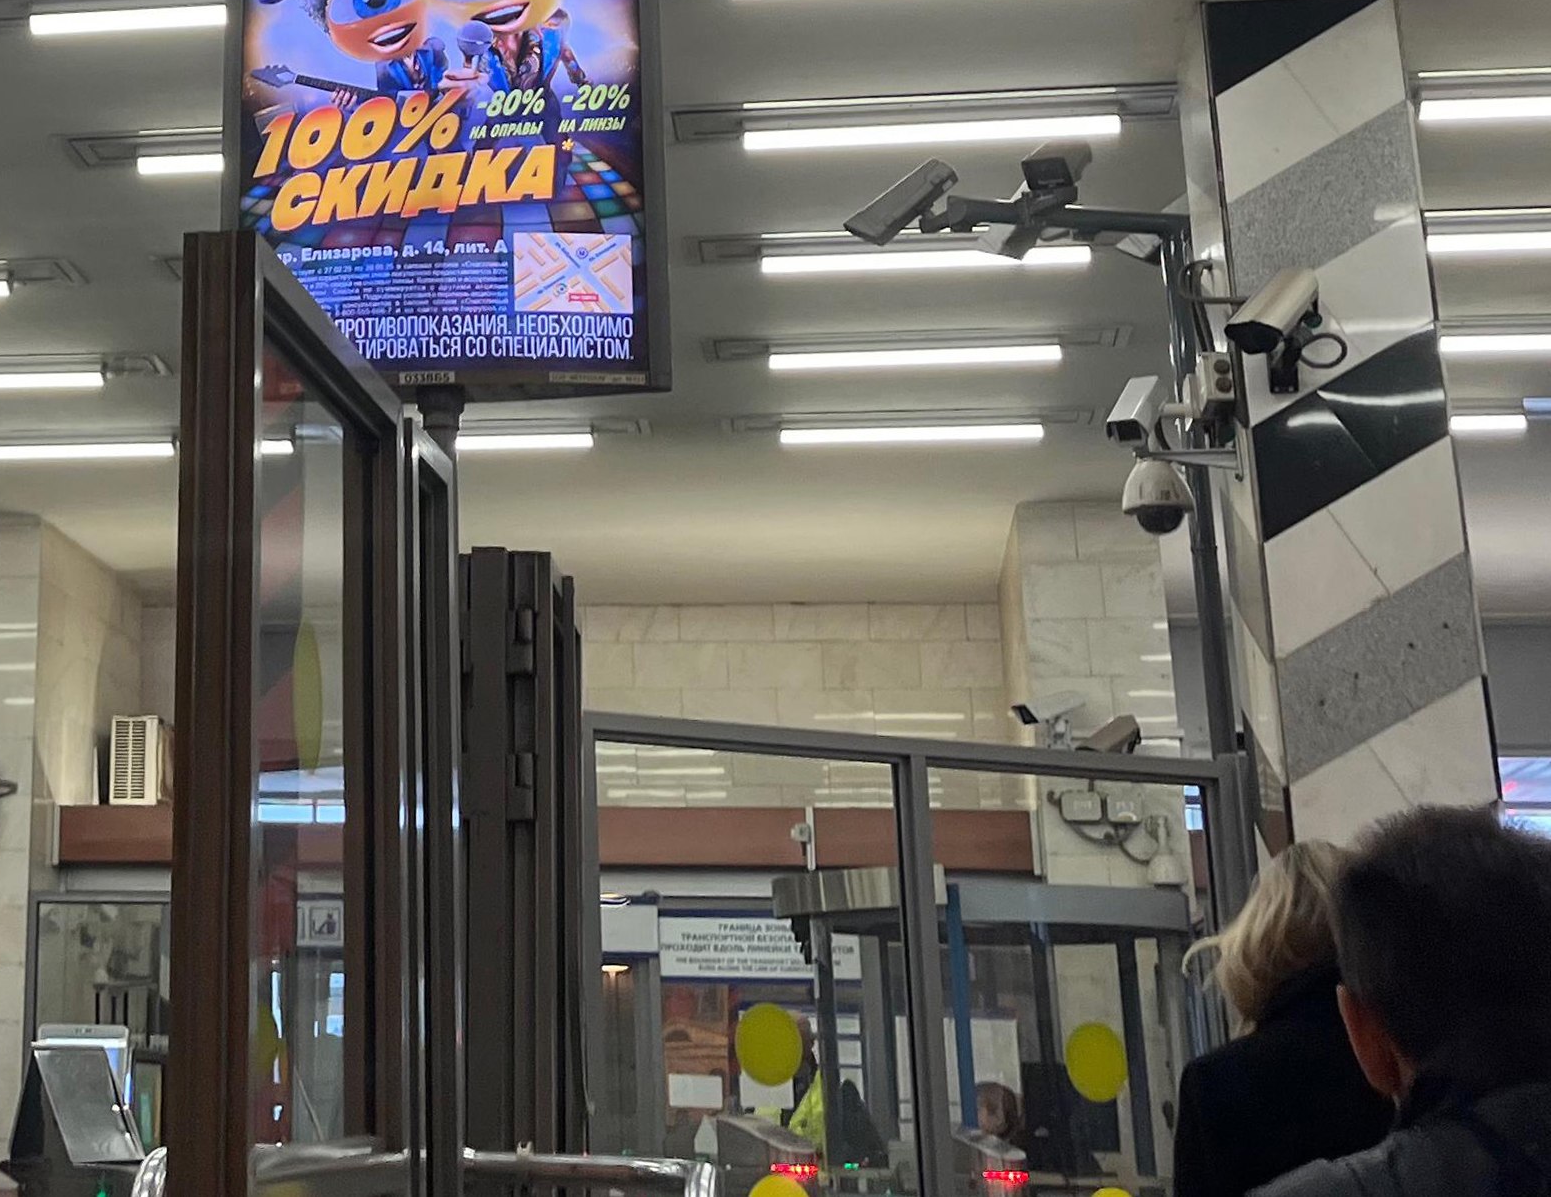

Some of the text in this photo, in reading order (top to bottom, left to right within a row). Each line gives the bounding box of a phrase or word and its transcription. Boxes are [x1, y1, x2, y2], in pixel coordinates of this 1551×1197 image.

[476, 88, 546, 117] -80%
[562, 84, 631, 111] -20%
[253, 87, 468, 179] 100%
[469, 120, 544, 140] НА ОПРАВЫ
[558, 115, 626, 134] НА ЛИНЗЫ
[301, 242, 399, 263] Елизарова,
[402, 243, 419, 258] д.
[423, 241, 450, 257] 14,
[453, 241, 489, 255] лит.
[517, 315, 634, 340] НЕОБХОДИМО
[355, 336, 635, 360] ТИРОВАТЬСЯ СО СПЕЦИАЛИСТОМ.
